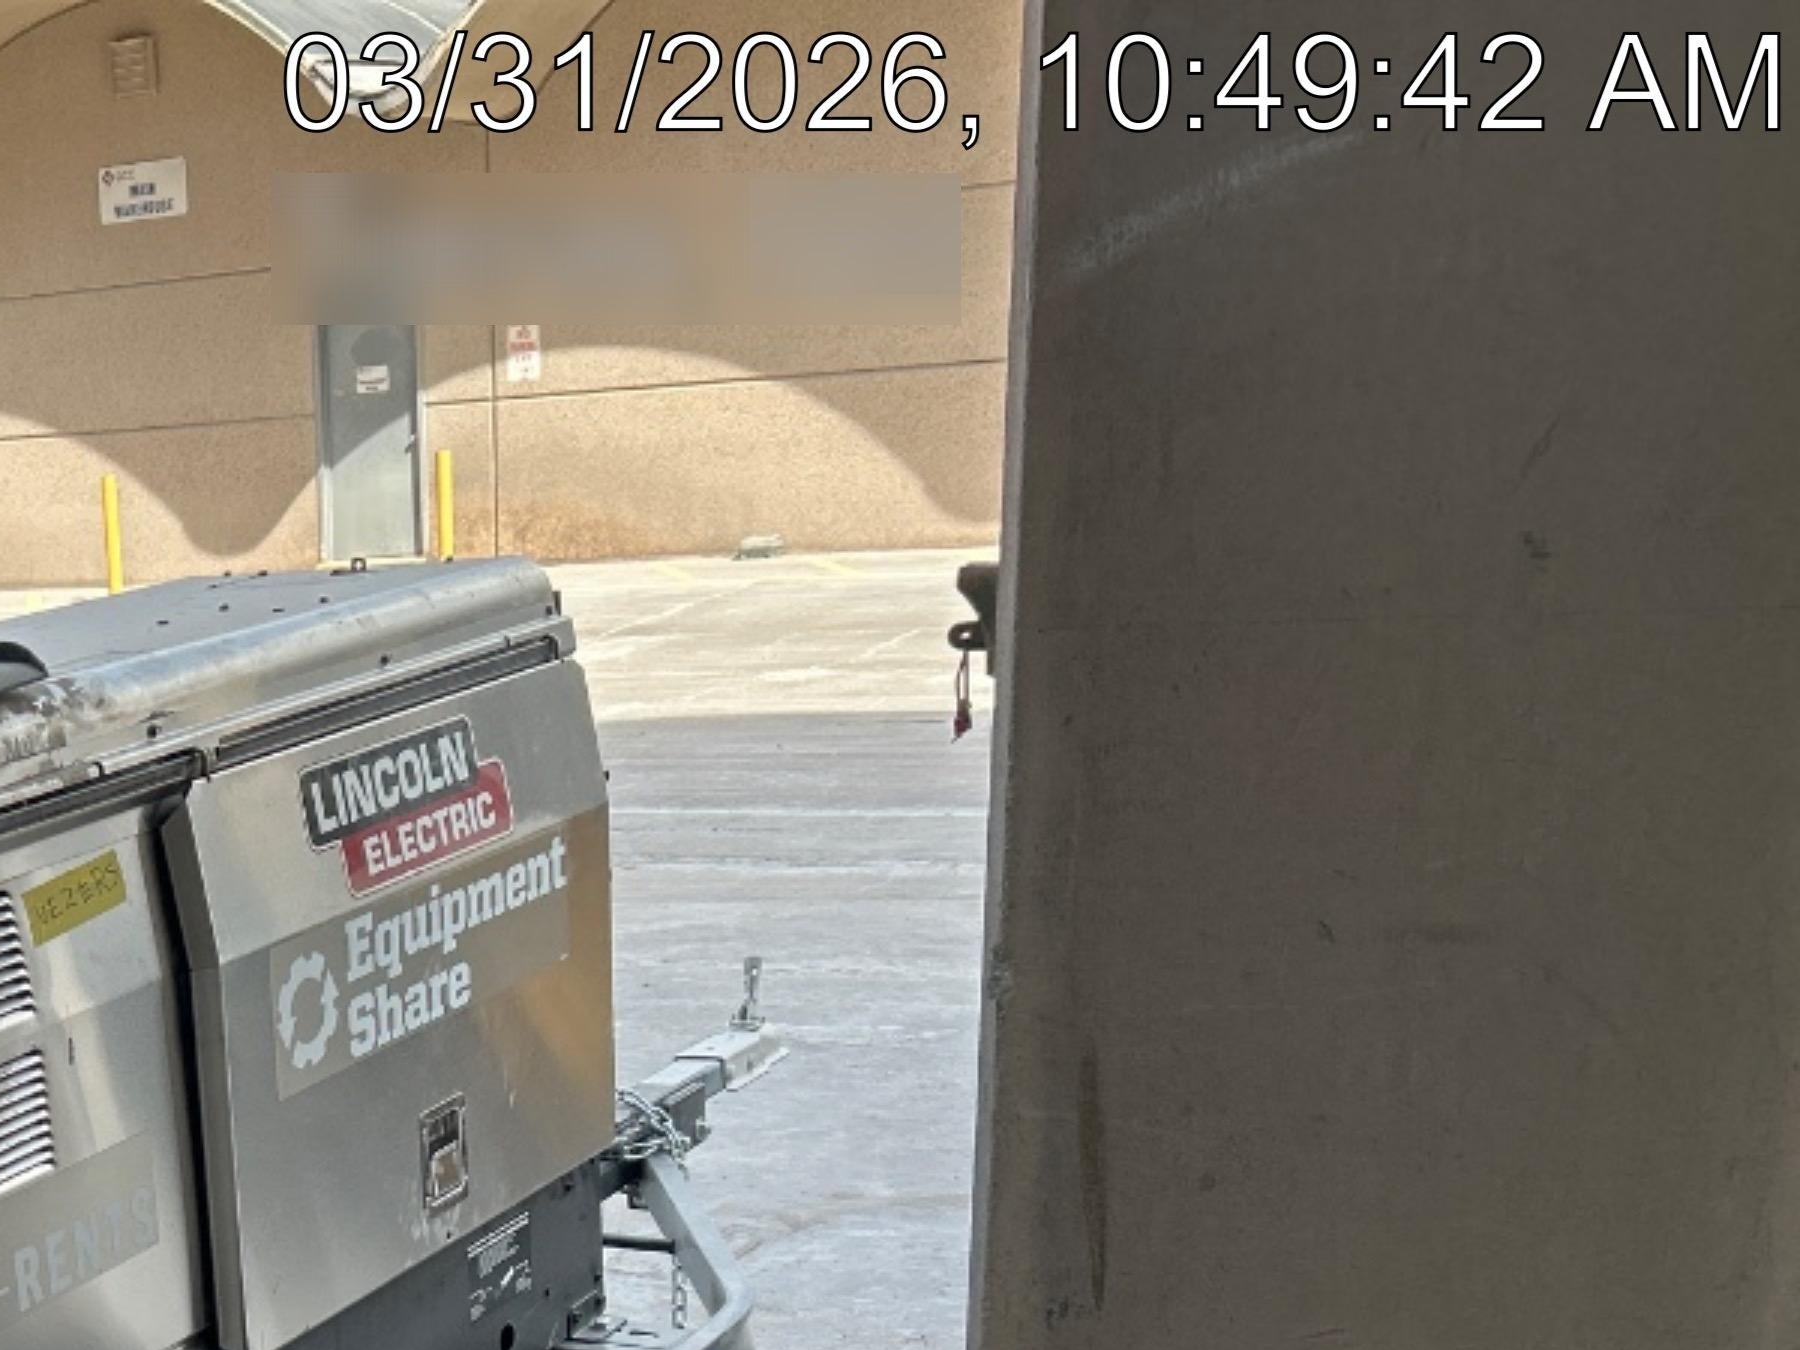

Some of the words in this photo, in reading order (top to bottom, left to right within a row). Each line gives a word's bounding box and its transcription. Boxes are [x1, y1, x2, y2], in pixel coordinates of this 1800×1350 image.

[310, 730, 472, 834] LINCOLN
[362, 791, 498, 877] ELECTRIC
[344, 836, 569, 984] Equipment
[347, 961, 473, 1059] Share
